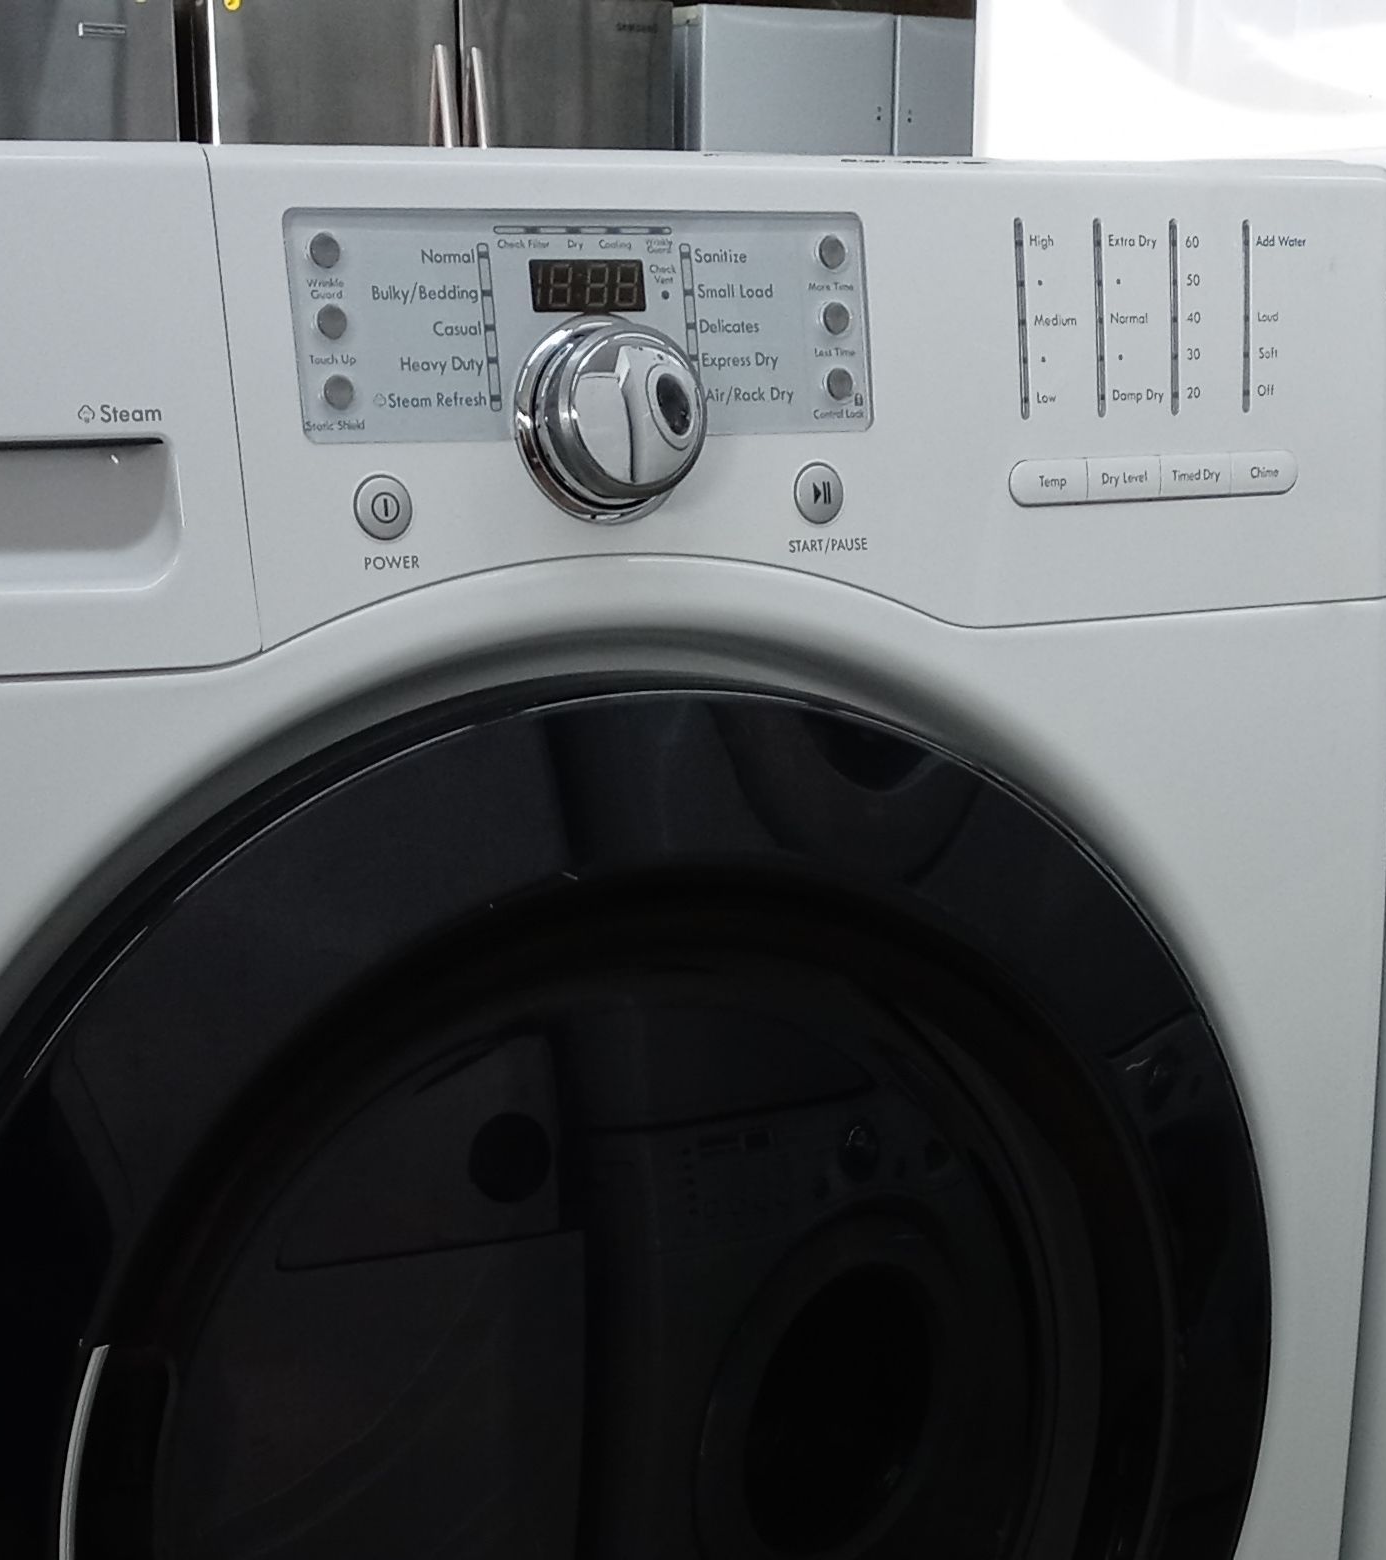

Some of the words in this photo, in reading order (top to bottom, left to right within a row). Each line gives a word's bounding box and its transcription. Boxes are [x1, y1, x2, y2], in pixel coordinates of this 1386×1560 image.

[567, 240, 584, 251] Dry
[1029, 235, 1054, 249] High
[1109, 235, 1135, 248] Extra
[1138, 235, 1157, 250] Dry
[1185, 236, 1200, 248] 60
[1256, 236, 1276, 248] Add
[1278, 236, 1306, 248] Water
[421, 249, 476, 265] Normal
[694, 248, 747, 264] Sanitize
[1186, 275, 1200, 287] 50
[371, 282, 479, 305] Bulky/Bedding
[697, 283, 735, 299] Small
[739, 283, 774, 299] Load
[1034, 315, 1077, 327] Medium
[1110, 313, 1148, 325] Normal
[1187, 312, 1201, 324] 40
[1257, 312, 1279, 323] Loud
[433, 321, 482, 337] Casual
[699, 319, 760, 334] Delicates
[309, 354, 339, 366] Touch
[341, 354, 357, 366] Up
[1187, 349, 1201, 361] 30
[1258, 348, 1278, 359] Soft
[400, 356, 447, 376] Heavy
[451, 356, 484, 376] Duty
[701, 352, 751, 370] Express
[755, 352, 779, 370] Dry
[705, 386, 765, 405] Air/Rack
[770, 386, 794, 404] Dry
[1036, 392, 1056, 404] Low
[1113, 389, 1143, 403] Damp
[1145, 389, 1164, 403] Dry
[1187, 387, 1201, 399] 20
[1257, 385, 1275, 397] Off
[388, 393, 432, 409] Steam
[436, 391, 487, 408] Refresh
[100, 404, 162, 423] Steam
[1101, 472, 1119, 488] Dry
[1123, 471, 1148, 484] Level
[1172, 468, 1201, 482] Timed
[1203, 468, 1221, 483] Dry
[1250, 466, 1279, 479] Chime
[1039, 475, 1067, 490] Temp
[788, 537, 868, 555] START/PAUSE
[364, 555, 420, 570] POWER
